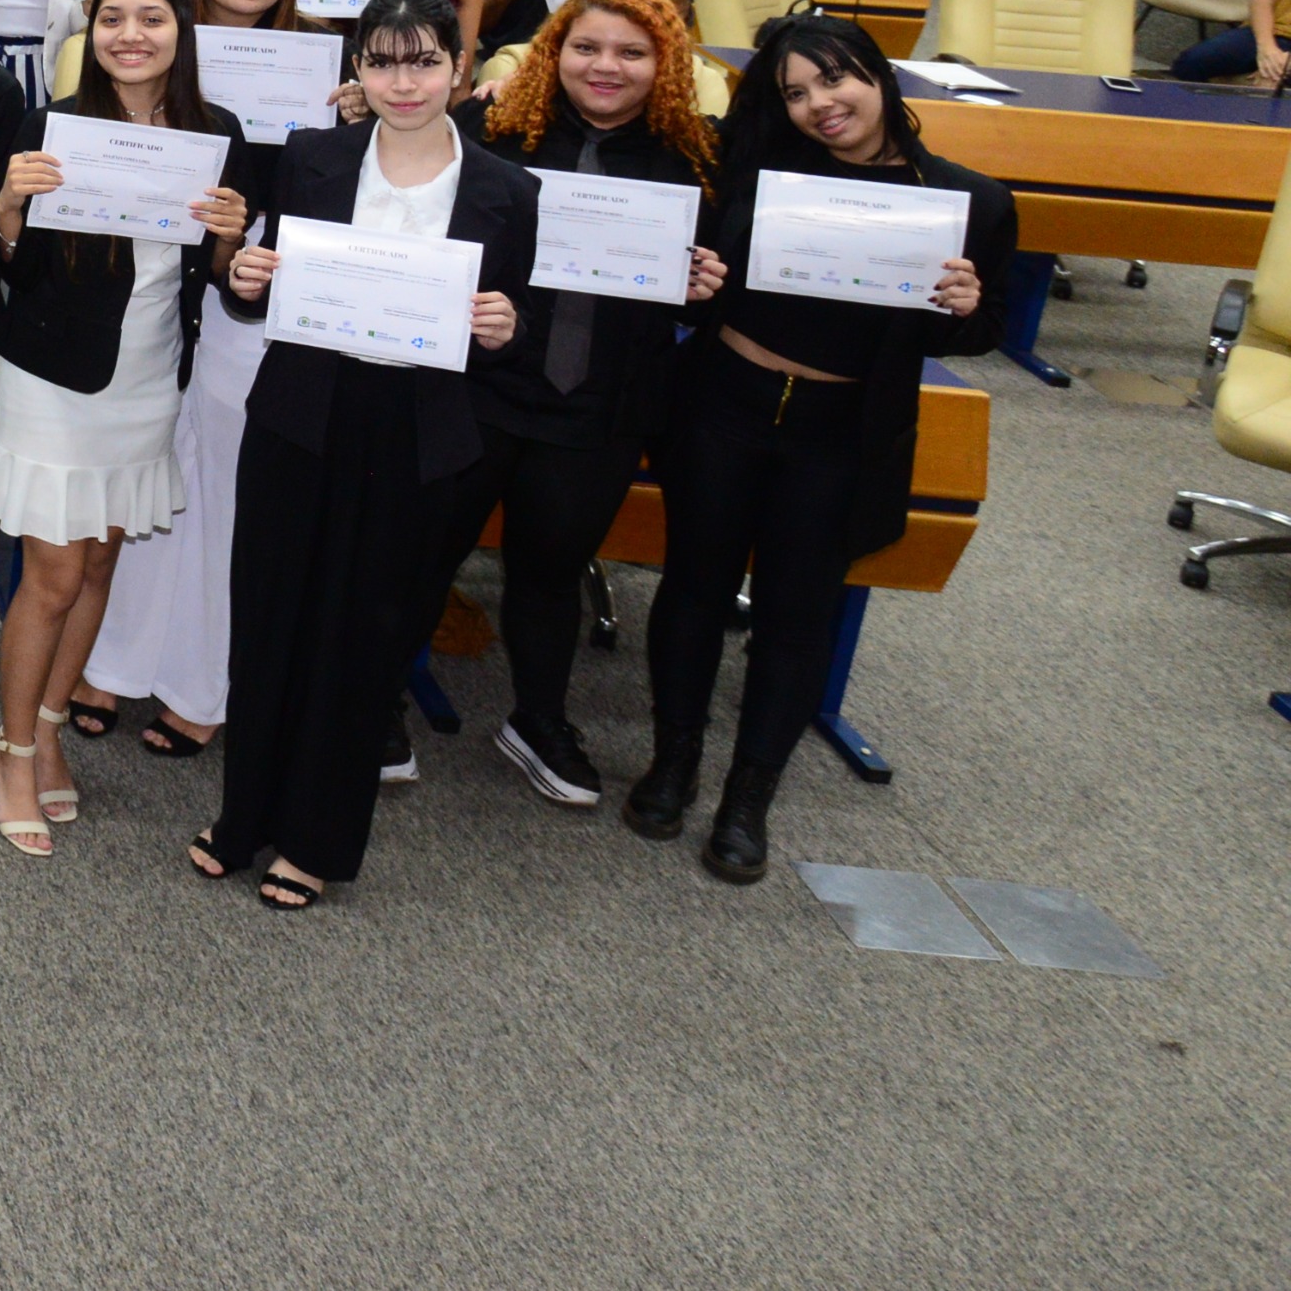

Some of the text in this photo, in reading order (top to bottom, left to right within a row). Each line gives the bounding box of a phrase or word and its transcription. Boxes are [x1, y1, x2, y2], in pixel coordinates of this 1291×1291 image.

[223, 44, 277, 55] CERTIFICADO
[109, 138, 163, 152] CERTIFICADO
[571, 191, 629, 204] CERTIFICADO
[829, 197, 891, 210] CERTIFICADO
[348, 244, 409, 260] CERTIFICADO
